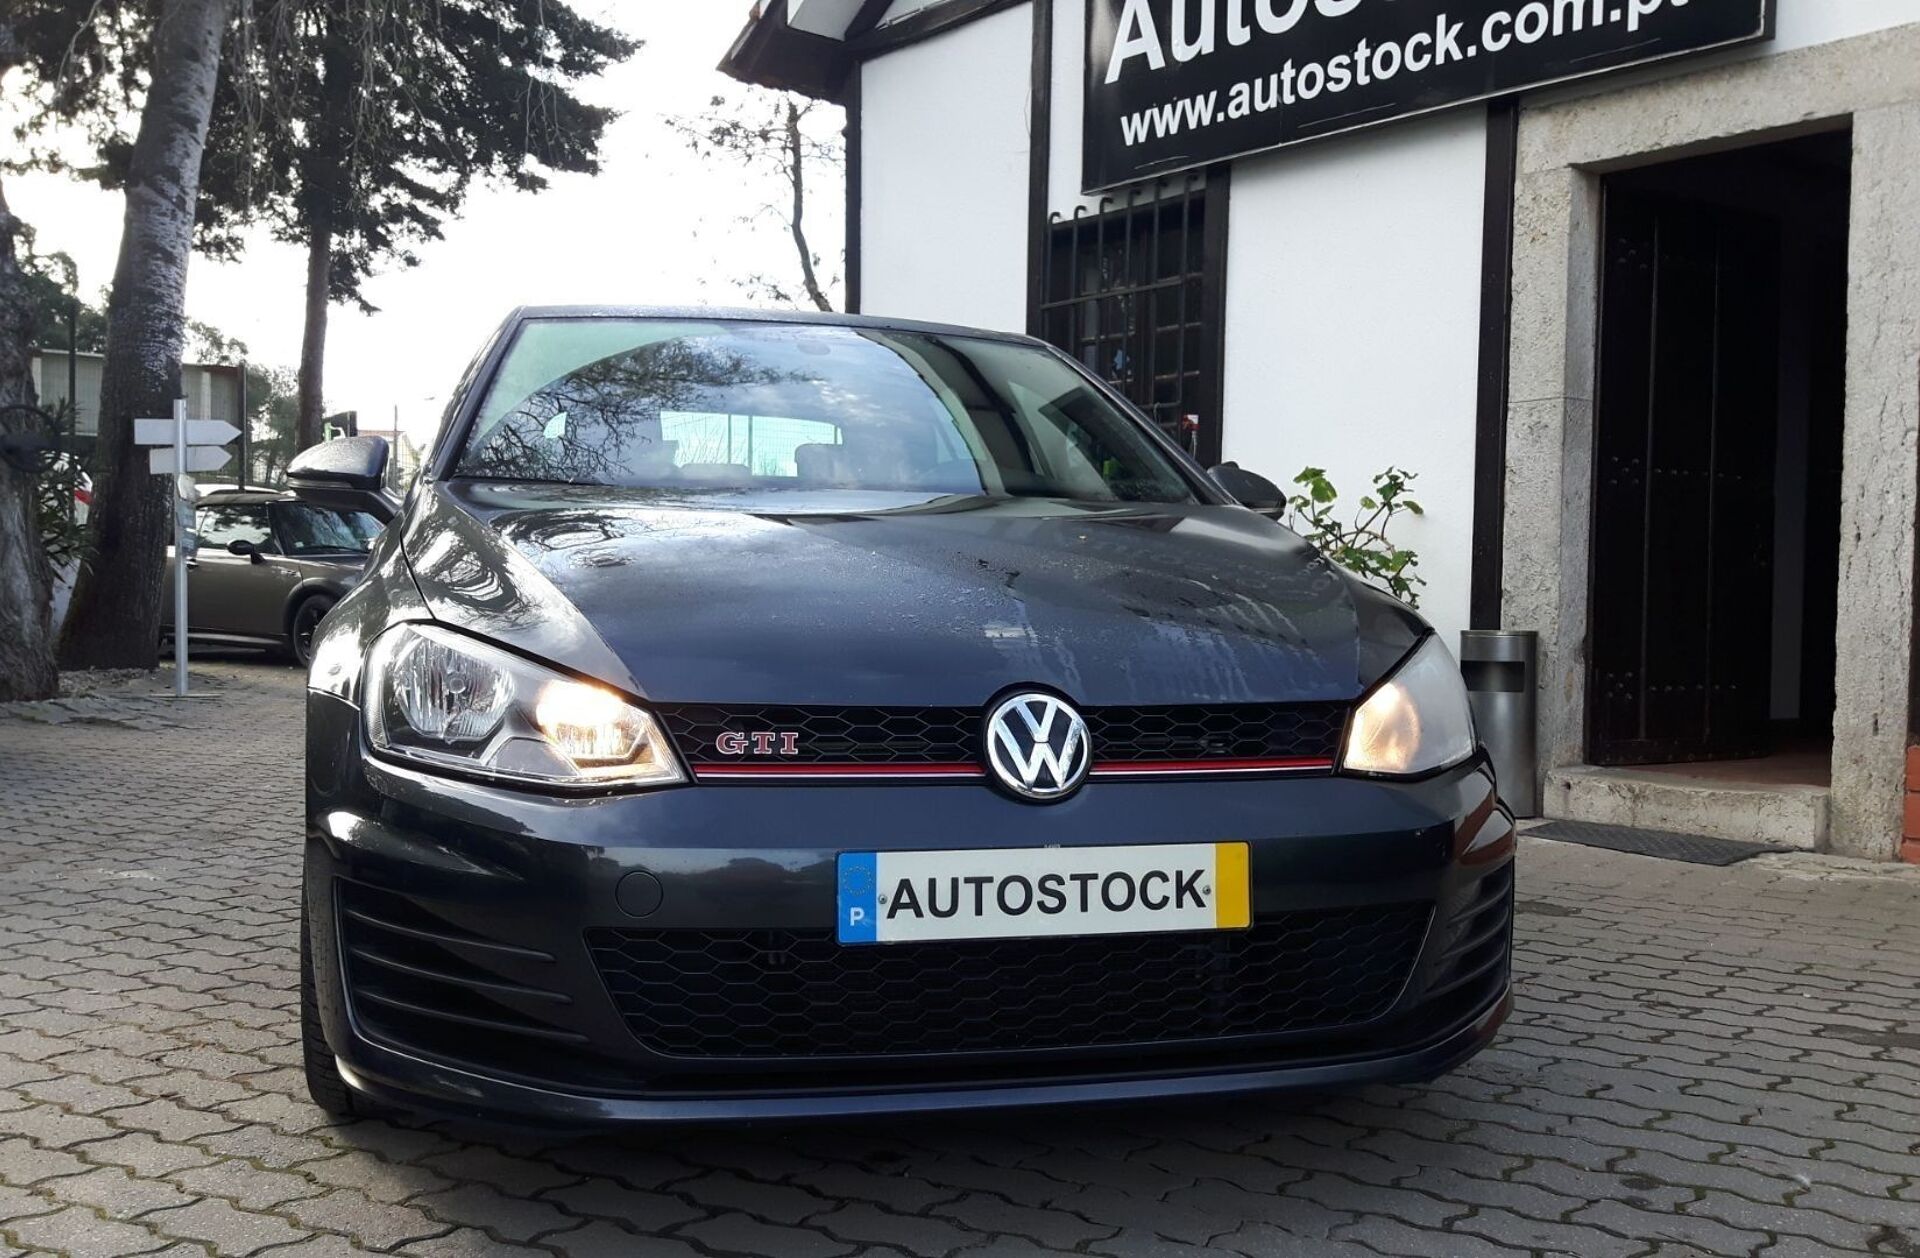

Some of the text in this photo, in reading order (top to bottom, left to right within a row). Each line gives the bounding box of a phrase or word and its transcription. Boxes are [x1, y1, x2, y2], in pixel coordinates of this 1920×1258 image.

[1120, 0, 1689, 146] www.autostock.com.p
[715, 731, 799, 755] GTI
[886, 869, 1207, 919] AUTOSTOCK
[850, 906, 865, 927] P
